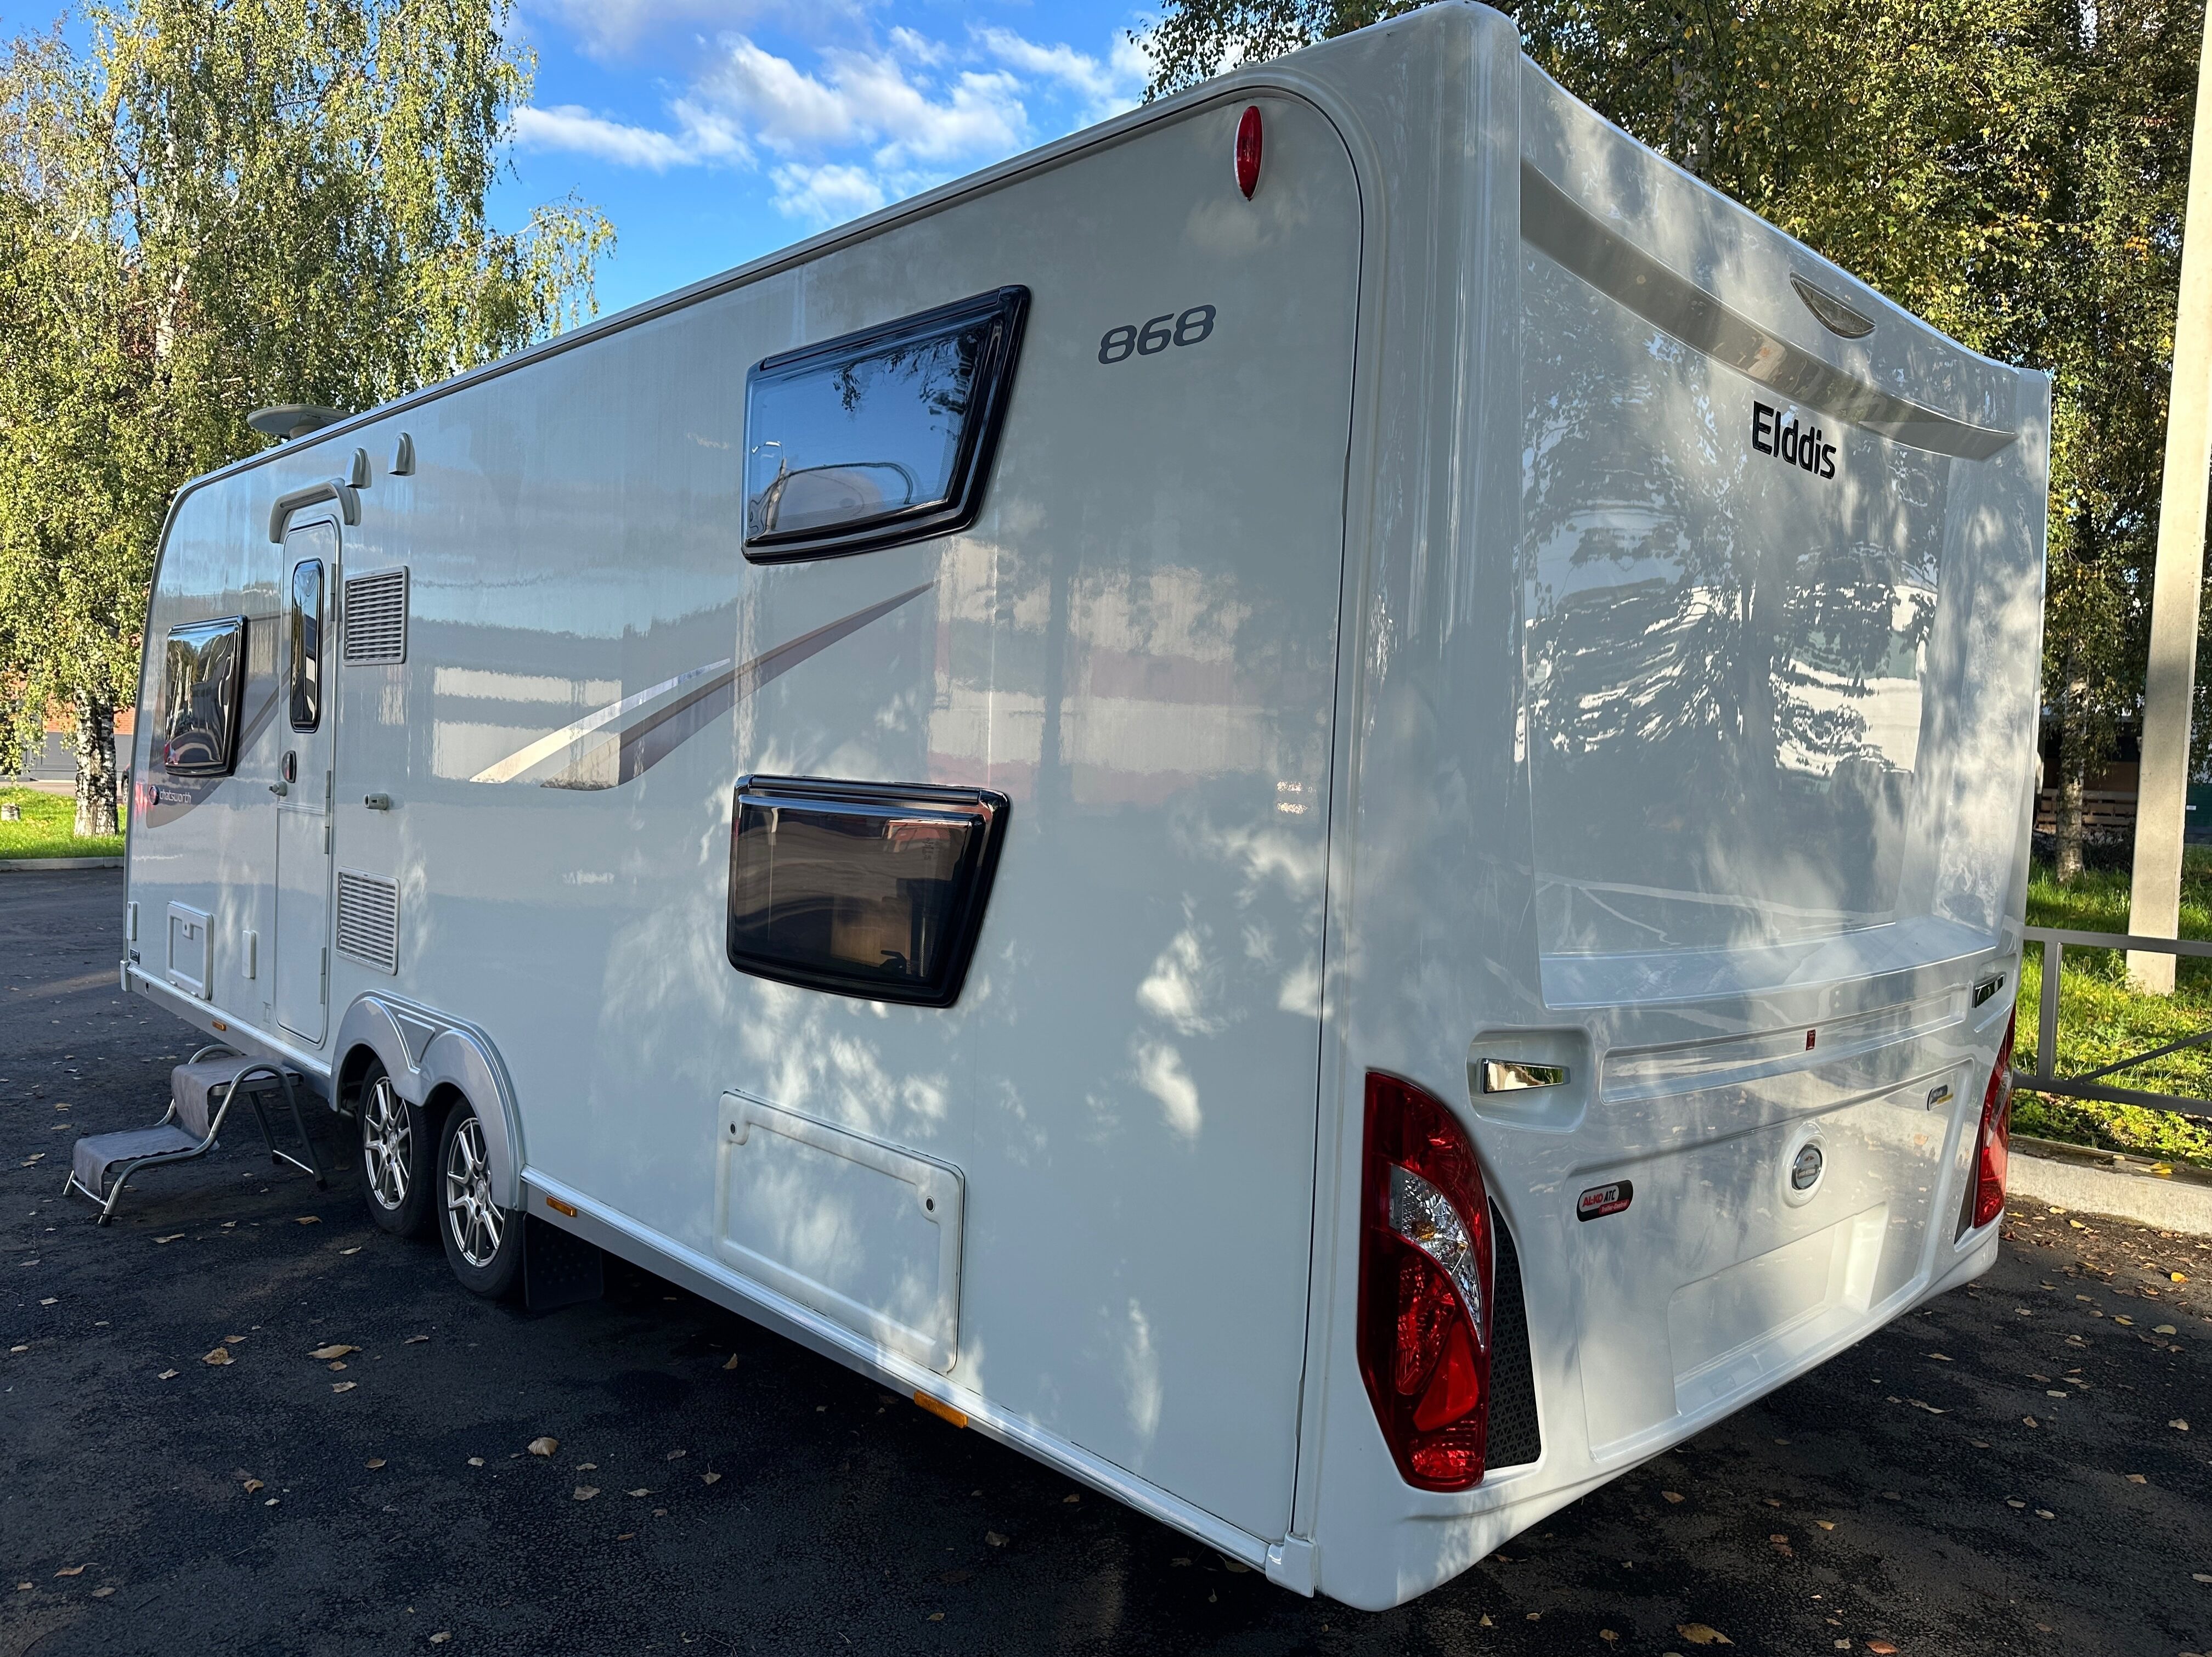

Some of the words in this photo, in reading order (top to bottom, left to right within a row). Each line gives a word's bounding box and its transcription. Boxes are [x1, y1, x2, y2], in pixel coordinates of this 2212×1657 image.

[1098, 304, 1216, 364] 868
[1752, 400, 1837, 480] Elddis
[159, 788, 191, 804] chatsworth
[1582, 1193, 1604, 1207] AL-KO
[1604, 1189, 1616, 1203] ATC
